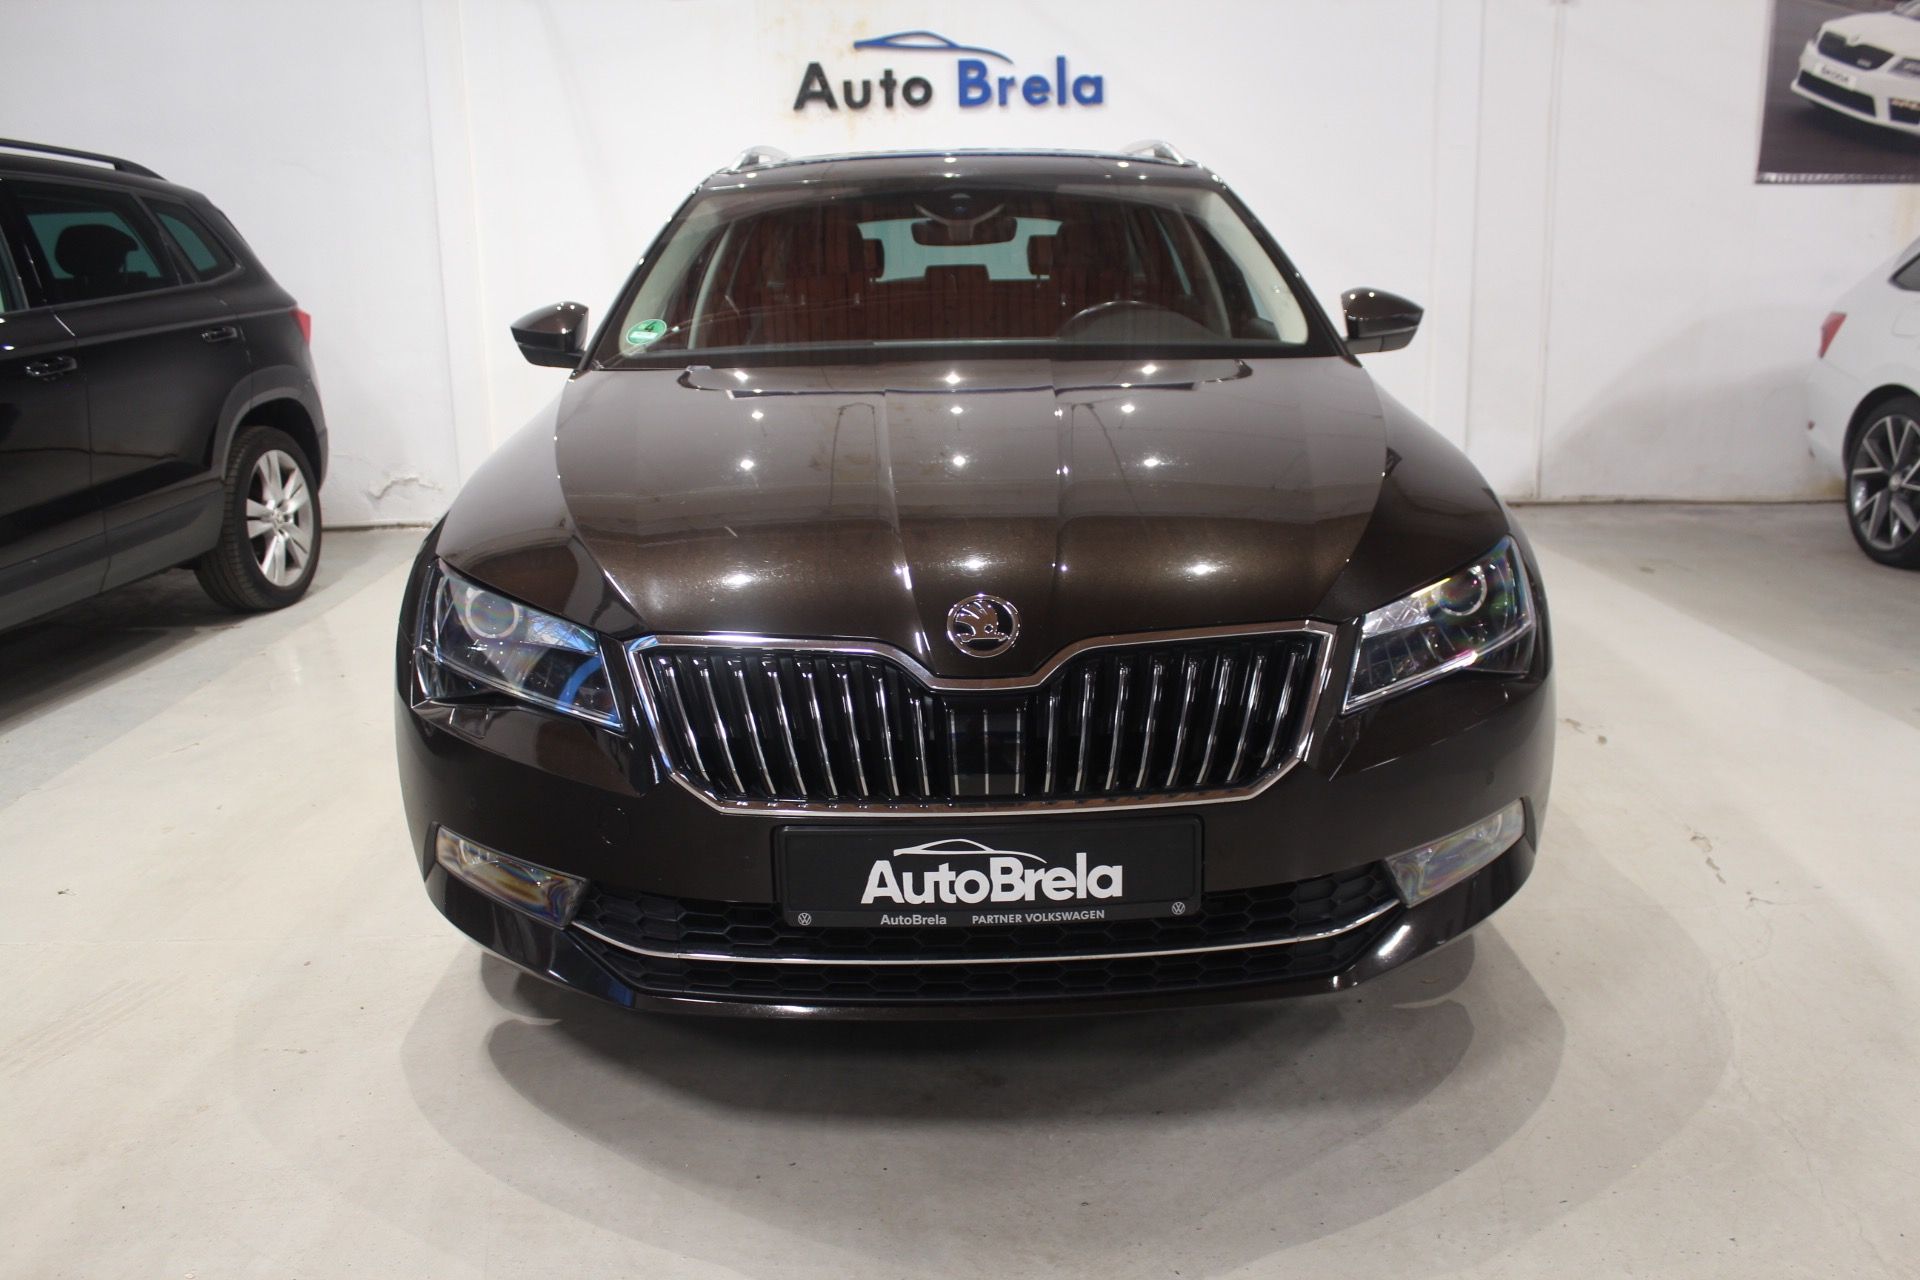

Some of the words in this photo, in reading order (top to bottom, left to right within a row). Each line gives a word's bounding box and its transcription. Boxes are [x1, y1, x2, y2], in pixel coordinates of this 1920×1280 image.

[793, 62, 933, 110] Auto
[957, 56, 1104, 107] Brela
[644, 321, 657, 332] 4
[860, 852, 1123, 905] AutoBrela
[880, 914, 947, 926] AutoBrela
[972, 913, 1022, 925] PARTNER
[1025, 910, 1105, 923] VOLKSWAGEN
